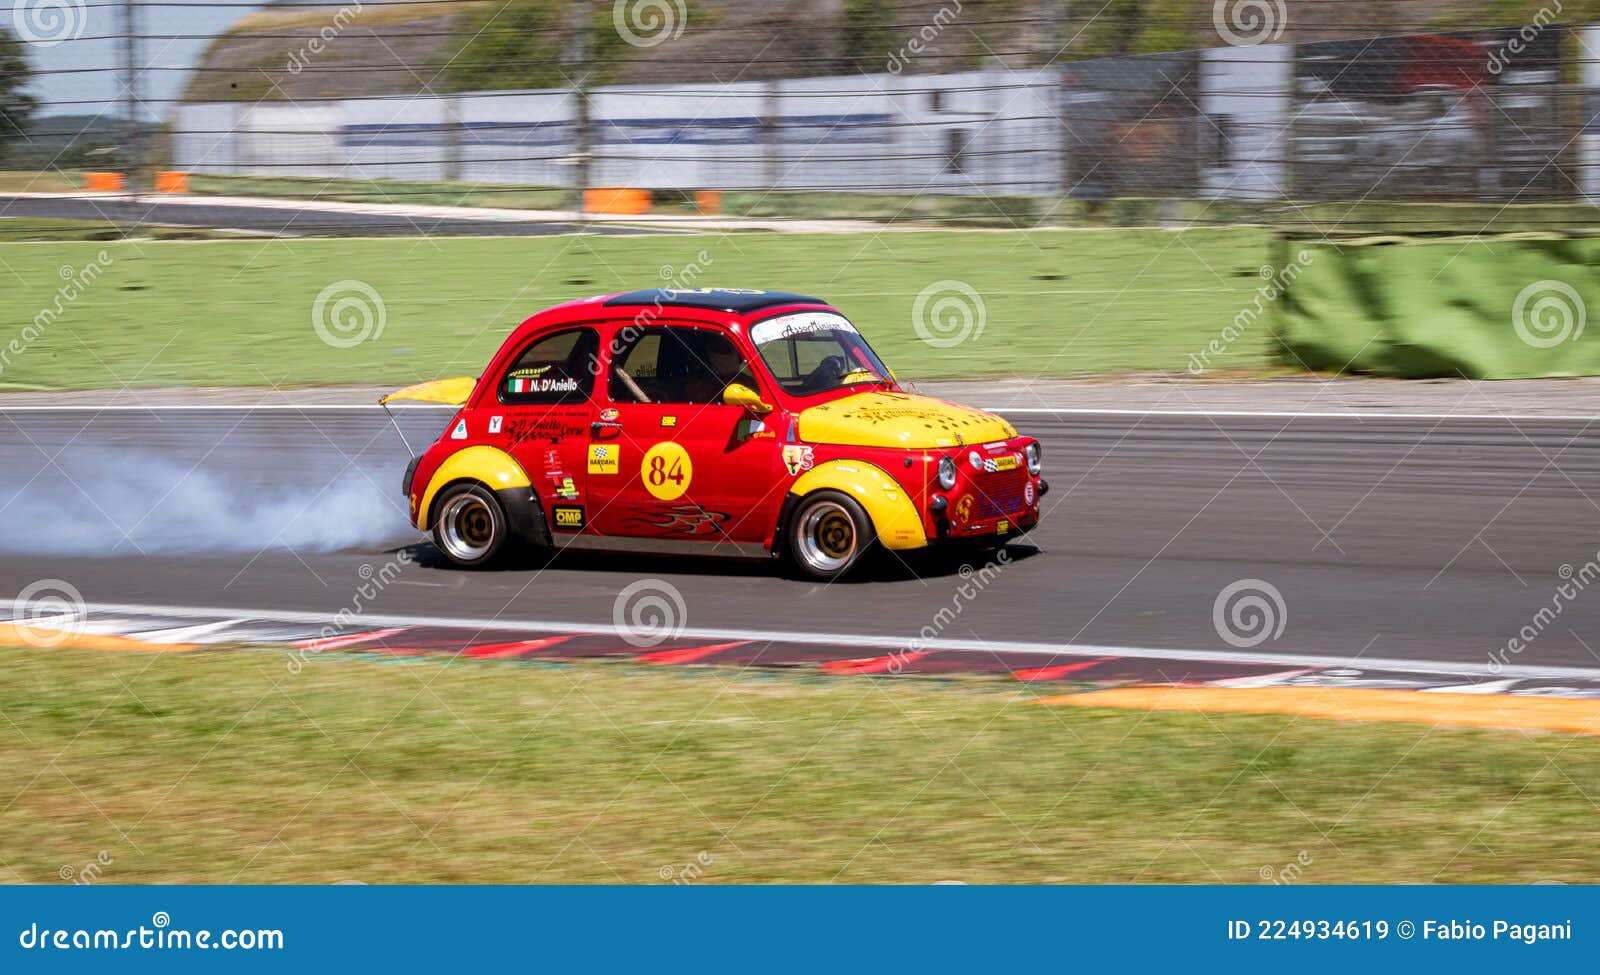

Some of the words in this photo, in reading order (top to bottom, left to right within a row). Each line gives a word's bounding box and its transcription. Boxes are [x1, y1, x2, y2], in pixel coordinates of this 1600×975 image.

[530, 379, 540, 392] N.
[541, 377, 578, 392] D'Aniello
[648, 455, 685, 486] 84
[556, 511, 582, 524] OMP
